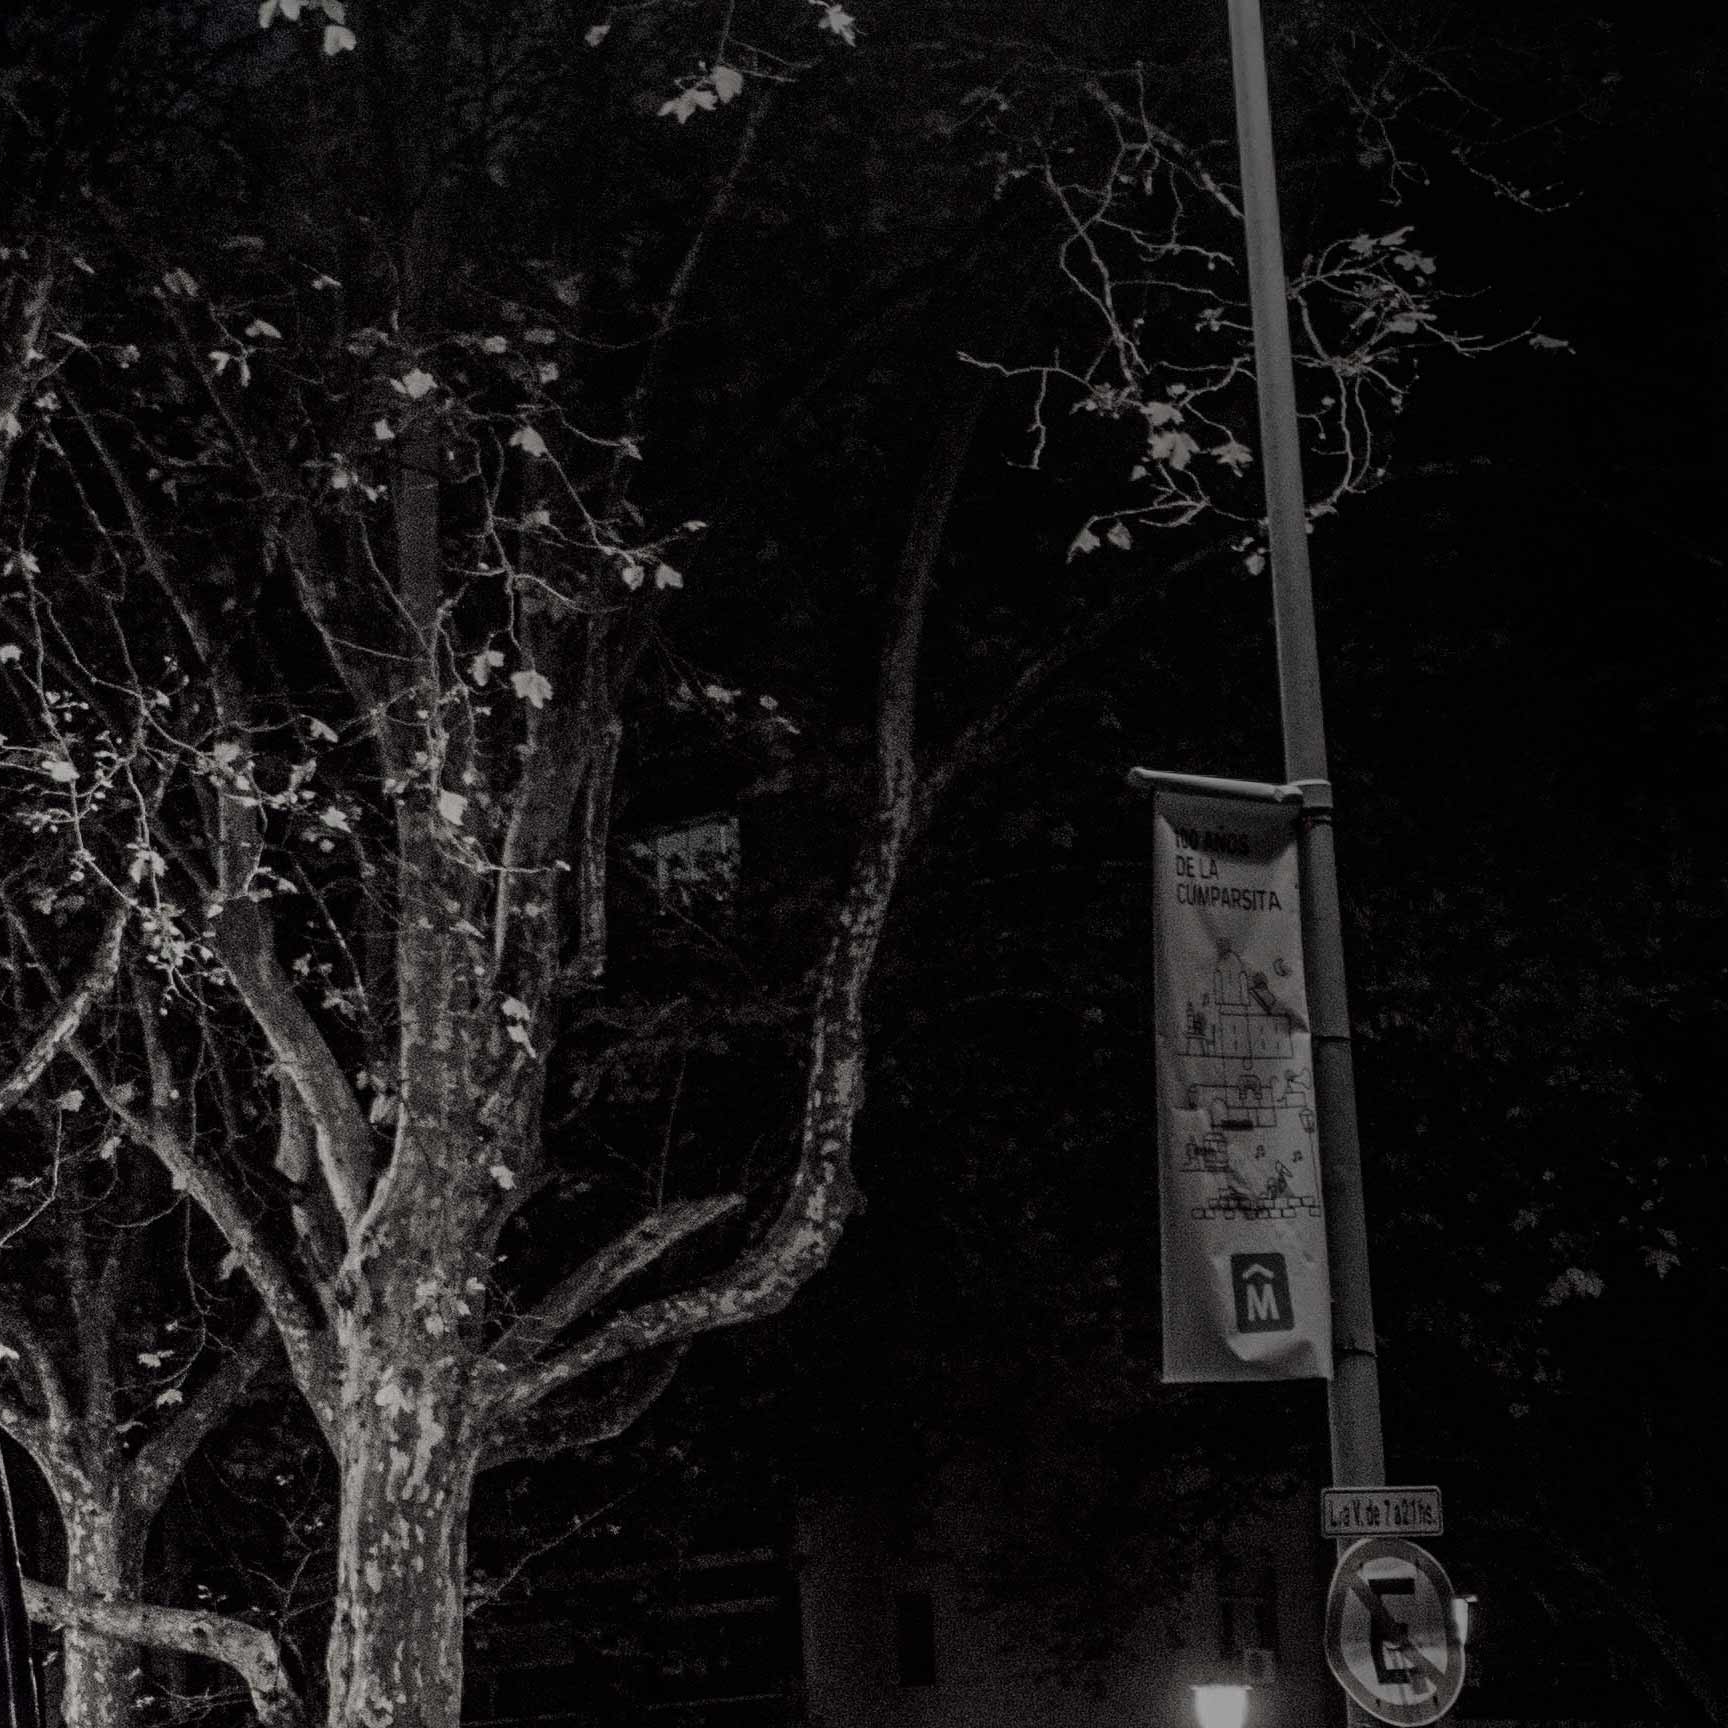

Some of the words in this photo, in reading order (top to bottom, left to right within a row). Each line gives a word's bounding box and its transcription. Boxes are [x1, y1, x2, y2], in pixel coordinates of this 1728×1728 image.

[1176, 855, 1196, 878] DE
[1200, 857, 1219, 880] LA
[1176, 883, 1282, 911] CUMPARSITA
